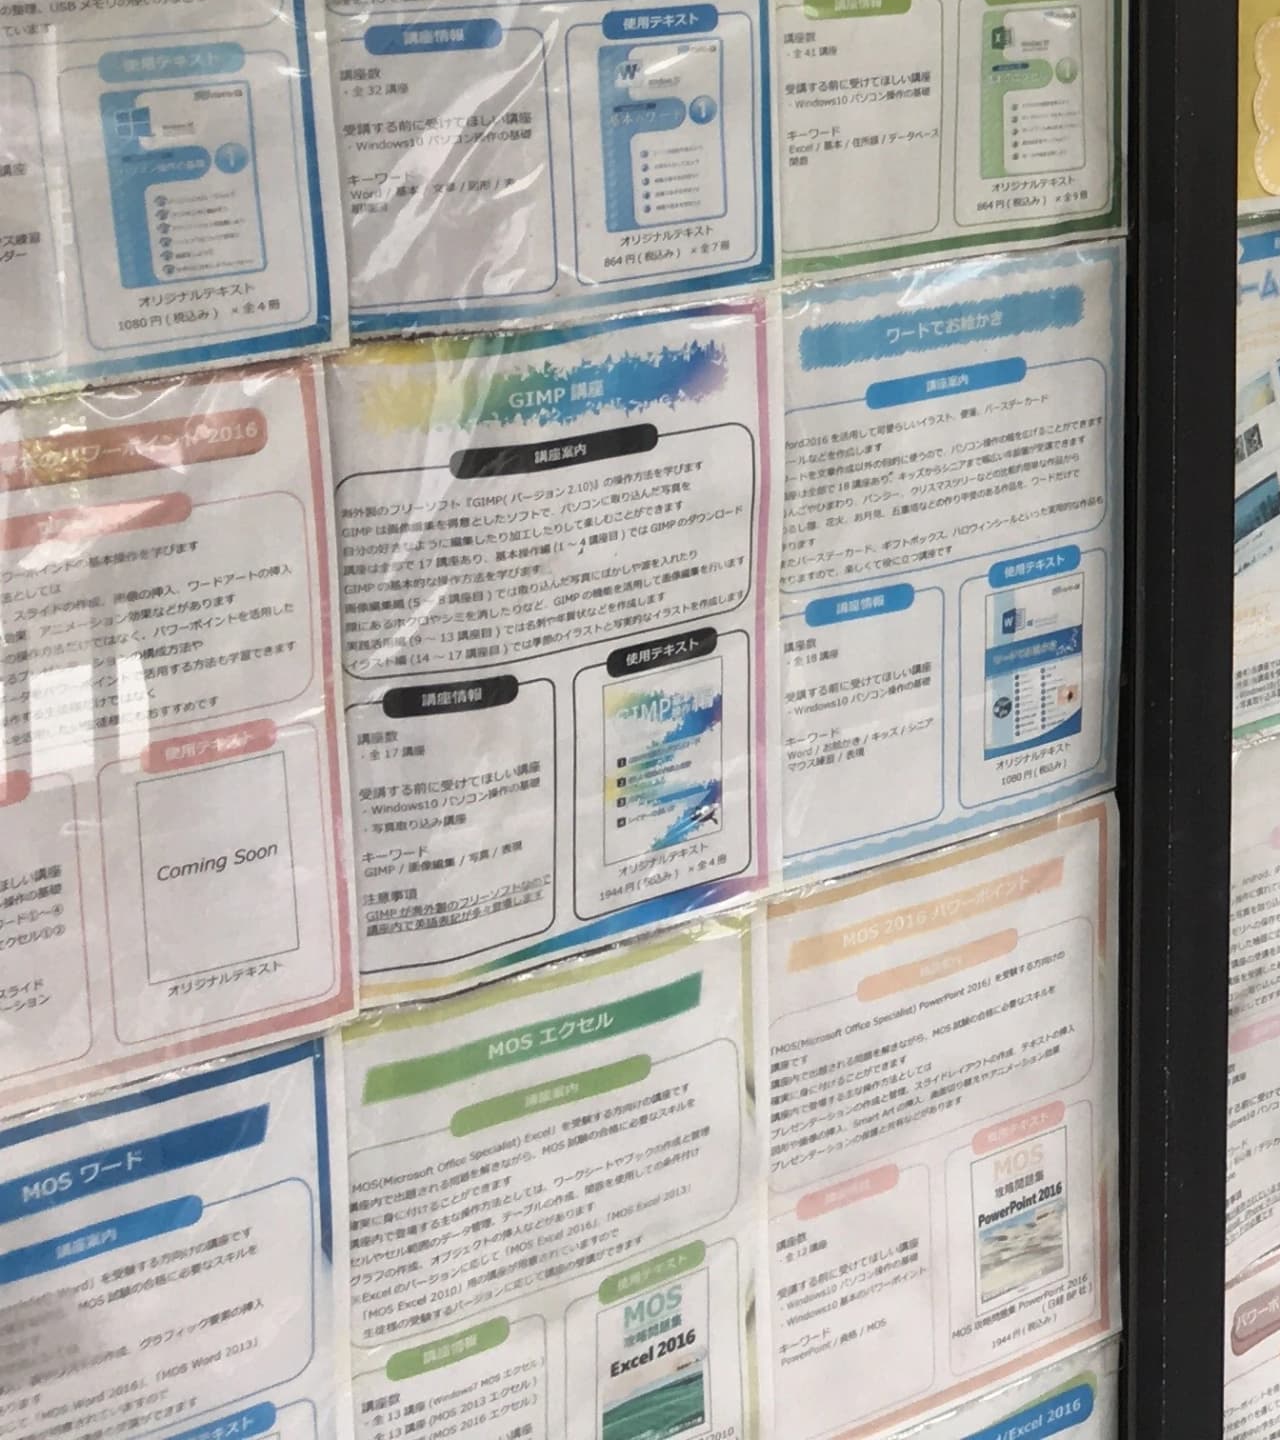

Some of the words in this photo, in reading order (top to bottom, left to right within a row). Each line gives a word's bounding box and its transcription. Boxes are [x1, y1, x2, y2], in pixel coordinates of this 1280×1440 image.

[623, 13, 699, 30] 使用テキスト
[887, 311, 1003, 344] ワードでお絵かき
[509, 388, 565, 409] GIMP
[571, 380, 605, 402] 講座
[208, 425, 258, 444] 2016
[1005, 555, 1065, 578] 使用テキスト
[626, 638, 699, 666] 使用テキスト
[421, 687, 482, 707] 講座情報
[785, 729, 840, 747] キーワード
[157, 853, 228, 882] Coming
[234, 843, 278, 866] Soon
[362, 845, 428, 863] キーワード
[842, 924, 882, 948] MOS
[885, 908, 926, 935] 2016
[487, 1035, 532, 1059] MOS
[540, 1013, 614, 1044] エクセル
[22, 1173, 73, 1203] MOS
[80, 1151, 143, 1182] ワード
[978, 1194, 1037, 1228] PowerPoint
[1039, 1182, 1063, 1202] 2016
[623, 1286, 682, 1328] MOS
[609, 1346, 654, 1378] Excel
[658, 1329, 696, 1358] 2016
[1047, 1399, 1081, 1422] 2016
